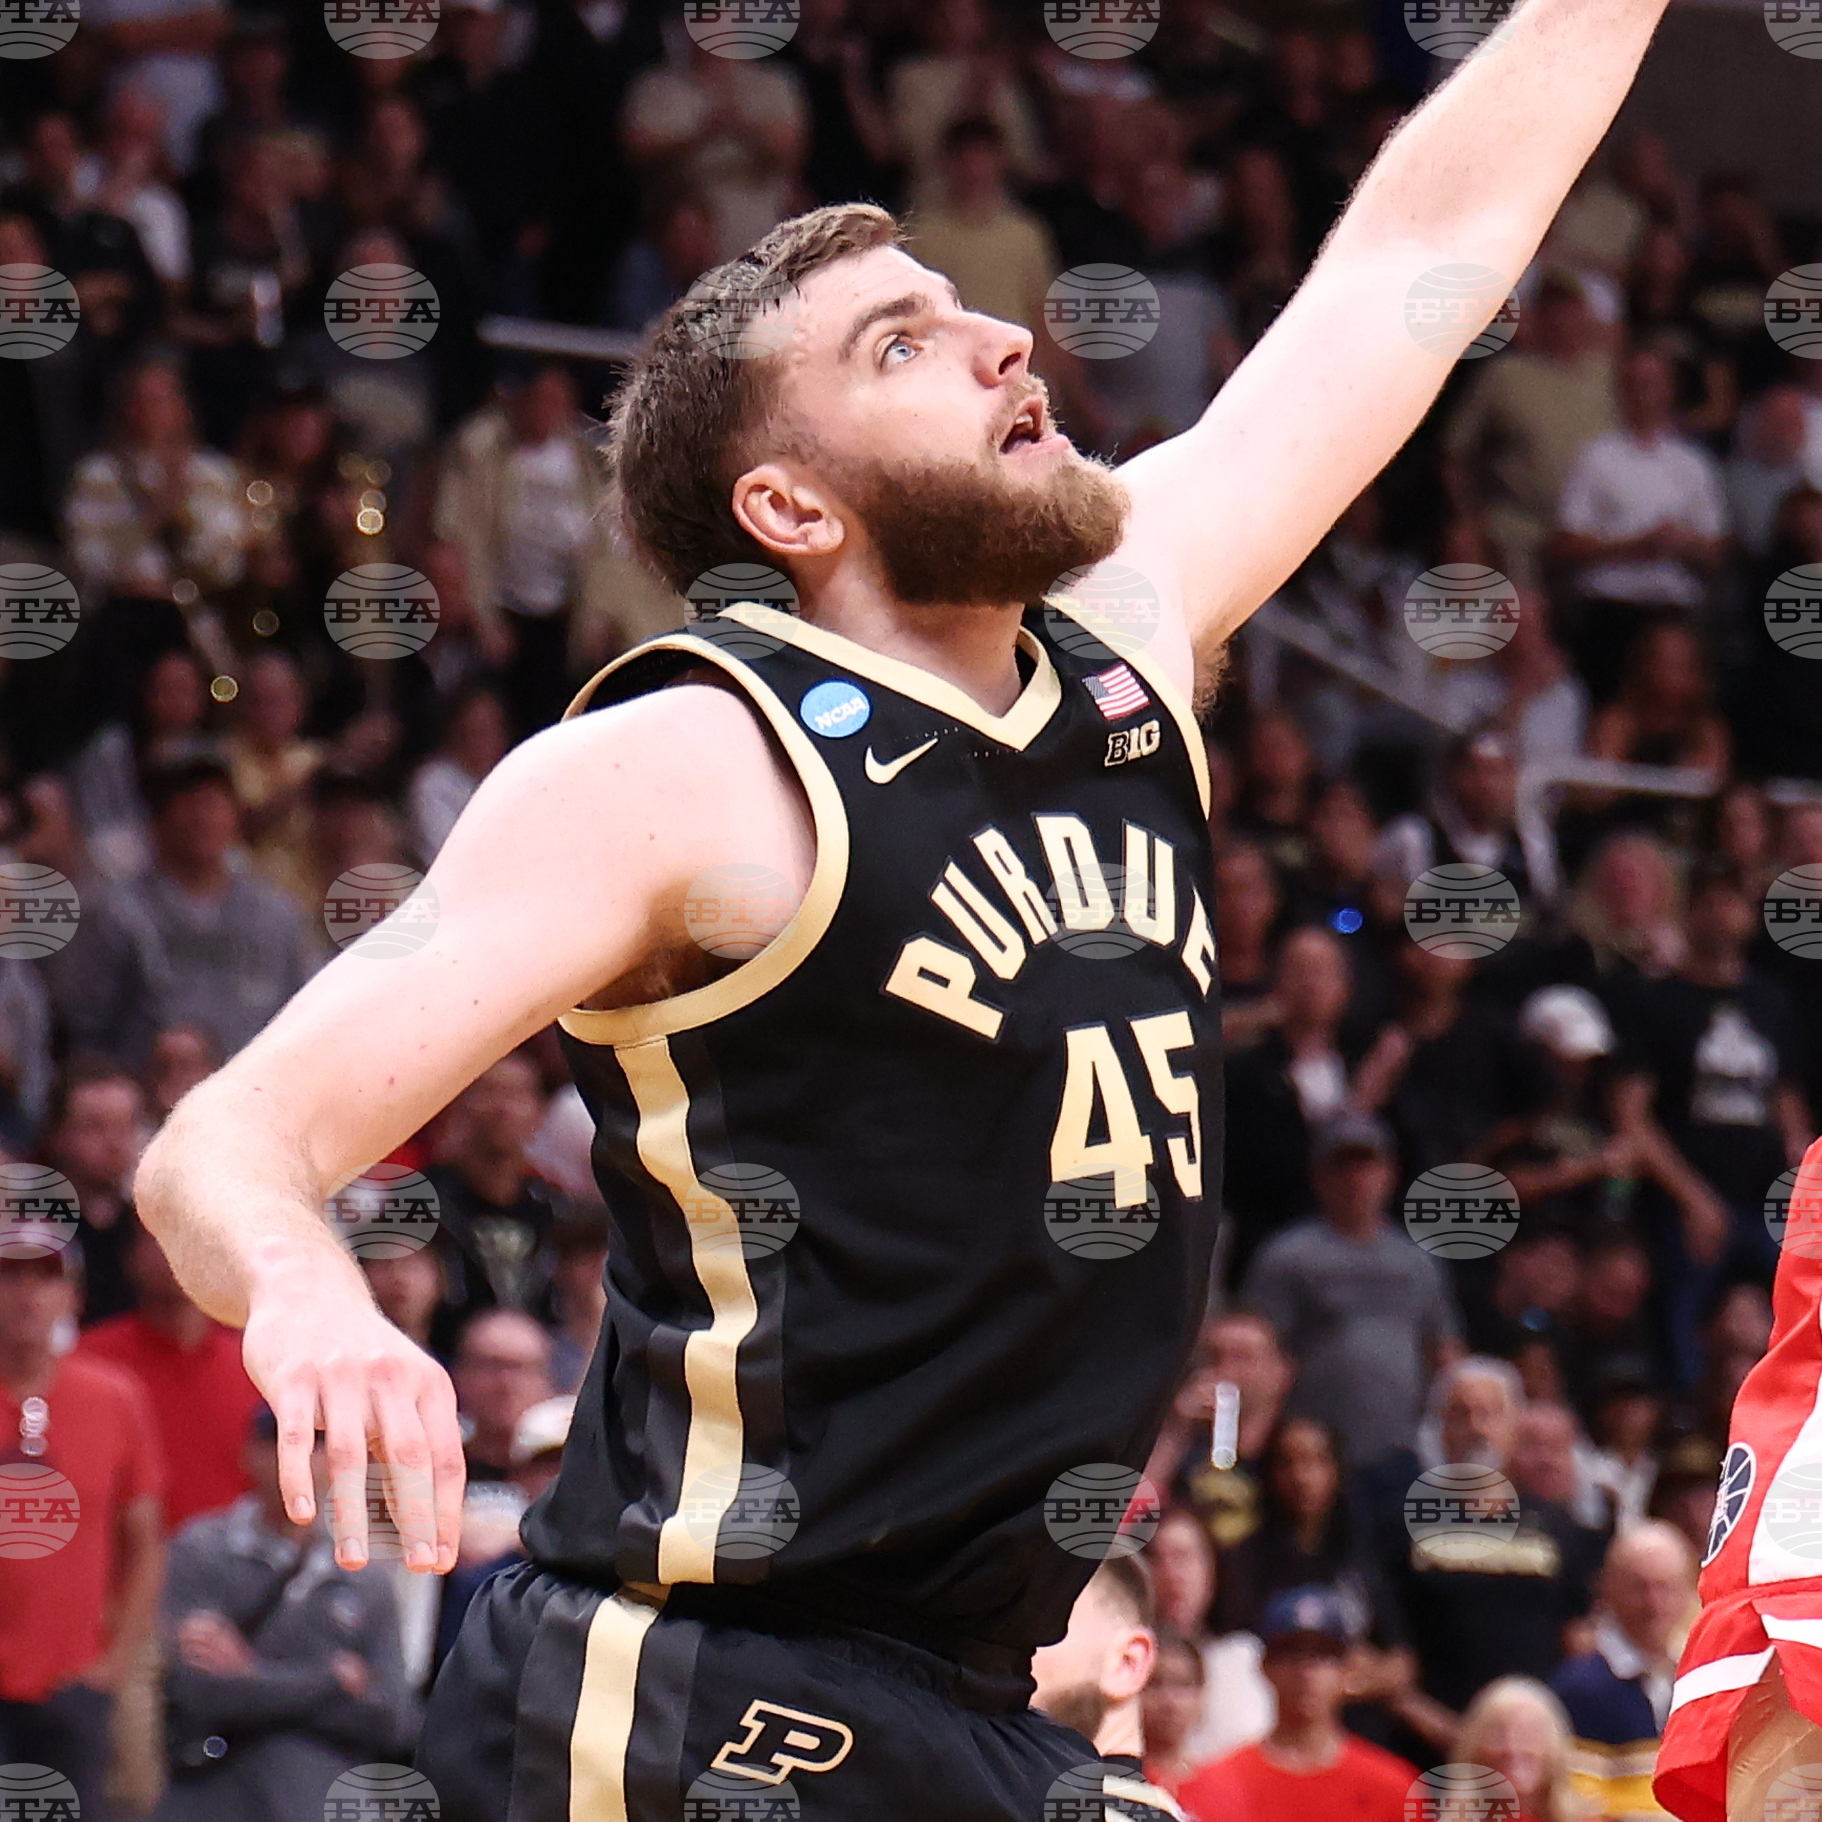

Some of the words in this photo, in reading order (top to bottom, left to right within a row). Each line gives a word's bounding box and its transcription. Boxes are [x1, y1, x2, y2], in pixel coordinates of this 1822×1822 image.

[814, 696, 867, 730] NCAA
[1049, 1009, 1203, 1210] 45
[710, 1697, 855, 1786] P
